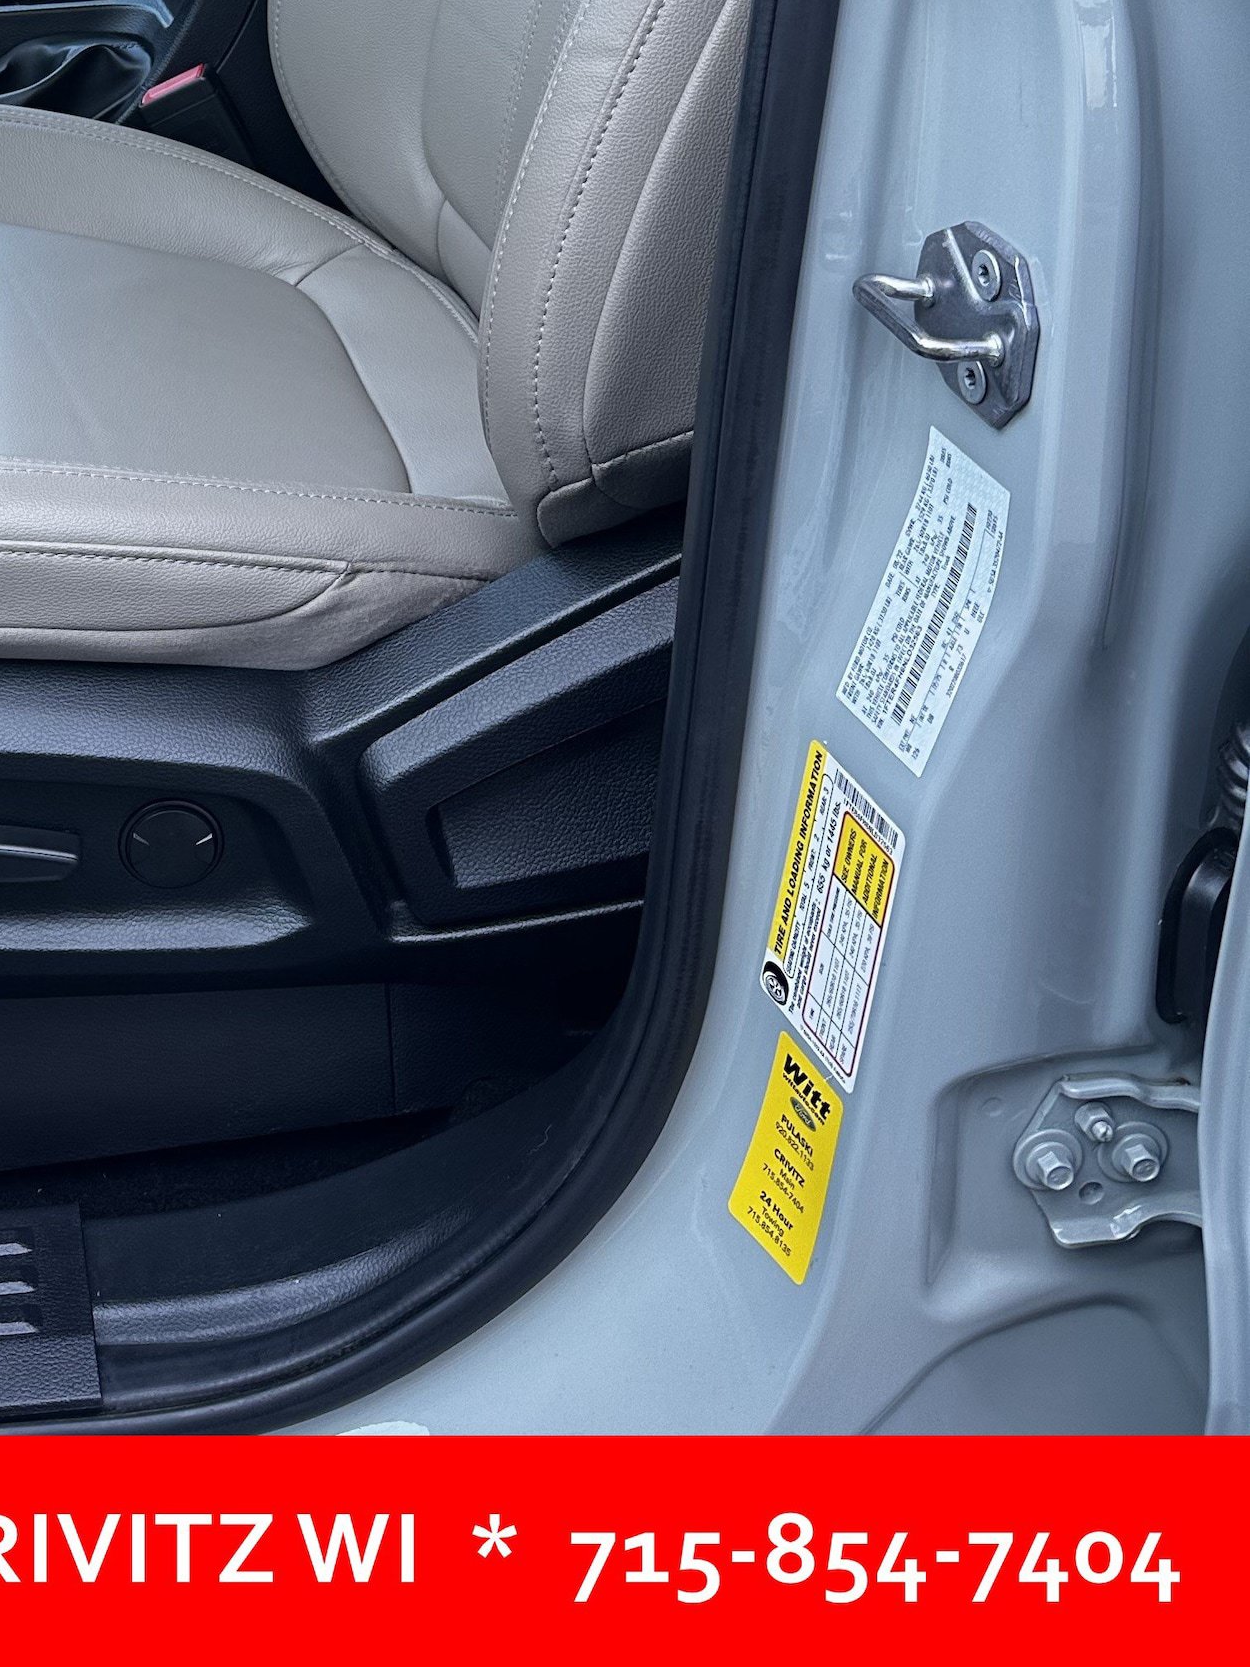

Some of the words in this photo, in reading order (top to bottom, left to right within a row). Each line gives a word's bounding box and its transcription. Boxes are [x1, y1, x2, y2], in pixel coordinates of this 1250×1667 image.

[913, 609, 922, 623] DATE
[919, 600, 926, 608] OF
[939, 536, 949, 557] SHOWN
[866, 706, 874, 719] THIS
[872, 684, 884, 705] VEHICLE
[894, 644, 900, 653] TO
[915, 577, 928, 600] FEDERAL
[926, 555, 936, 576] MOTOR
[933, 531, 944, 554] VEHICLE
[824, 787, 829, 795] 3
[814, 834, 819, 842] 2
[827, 817, 837, 843] 1445
[774, 925, 786, 954] TIRE
[781, 897, 791, 926] AND
[787, 840, 804, 897] LOADING
[799, 750, 822, 840] INFORMATION
[822, 858, 830, 871] kg
[826, 845, 831, 857] or
[841, 865, 849, 883] SEE
[845, 828, 857, 865] OWNERS
[851, 859, 863, 895] MANUAL
[859, 839, 867, 859] FOR
[817, 873, 825, 893] 655
[862, 854, 877, 905] ADDITIONAL
[872, 859, 889, 919] INFORMATION
[784, 1054, 830, 1120] Witt
[794, 1100, 812, 1127] Ford
[781, 1114, 813, 1157] PULASKI
[774, 1149, 805, 1188] CRIVITZ
[779, 1169, 795, 1190] Main
[760, 1191, 772, 1207] 24
[772, 1204, 793, 1230] Hour
[762, 1206, 784, 1237] Towing
